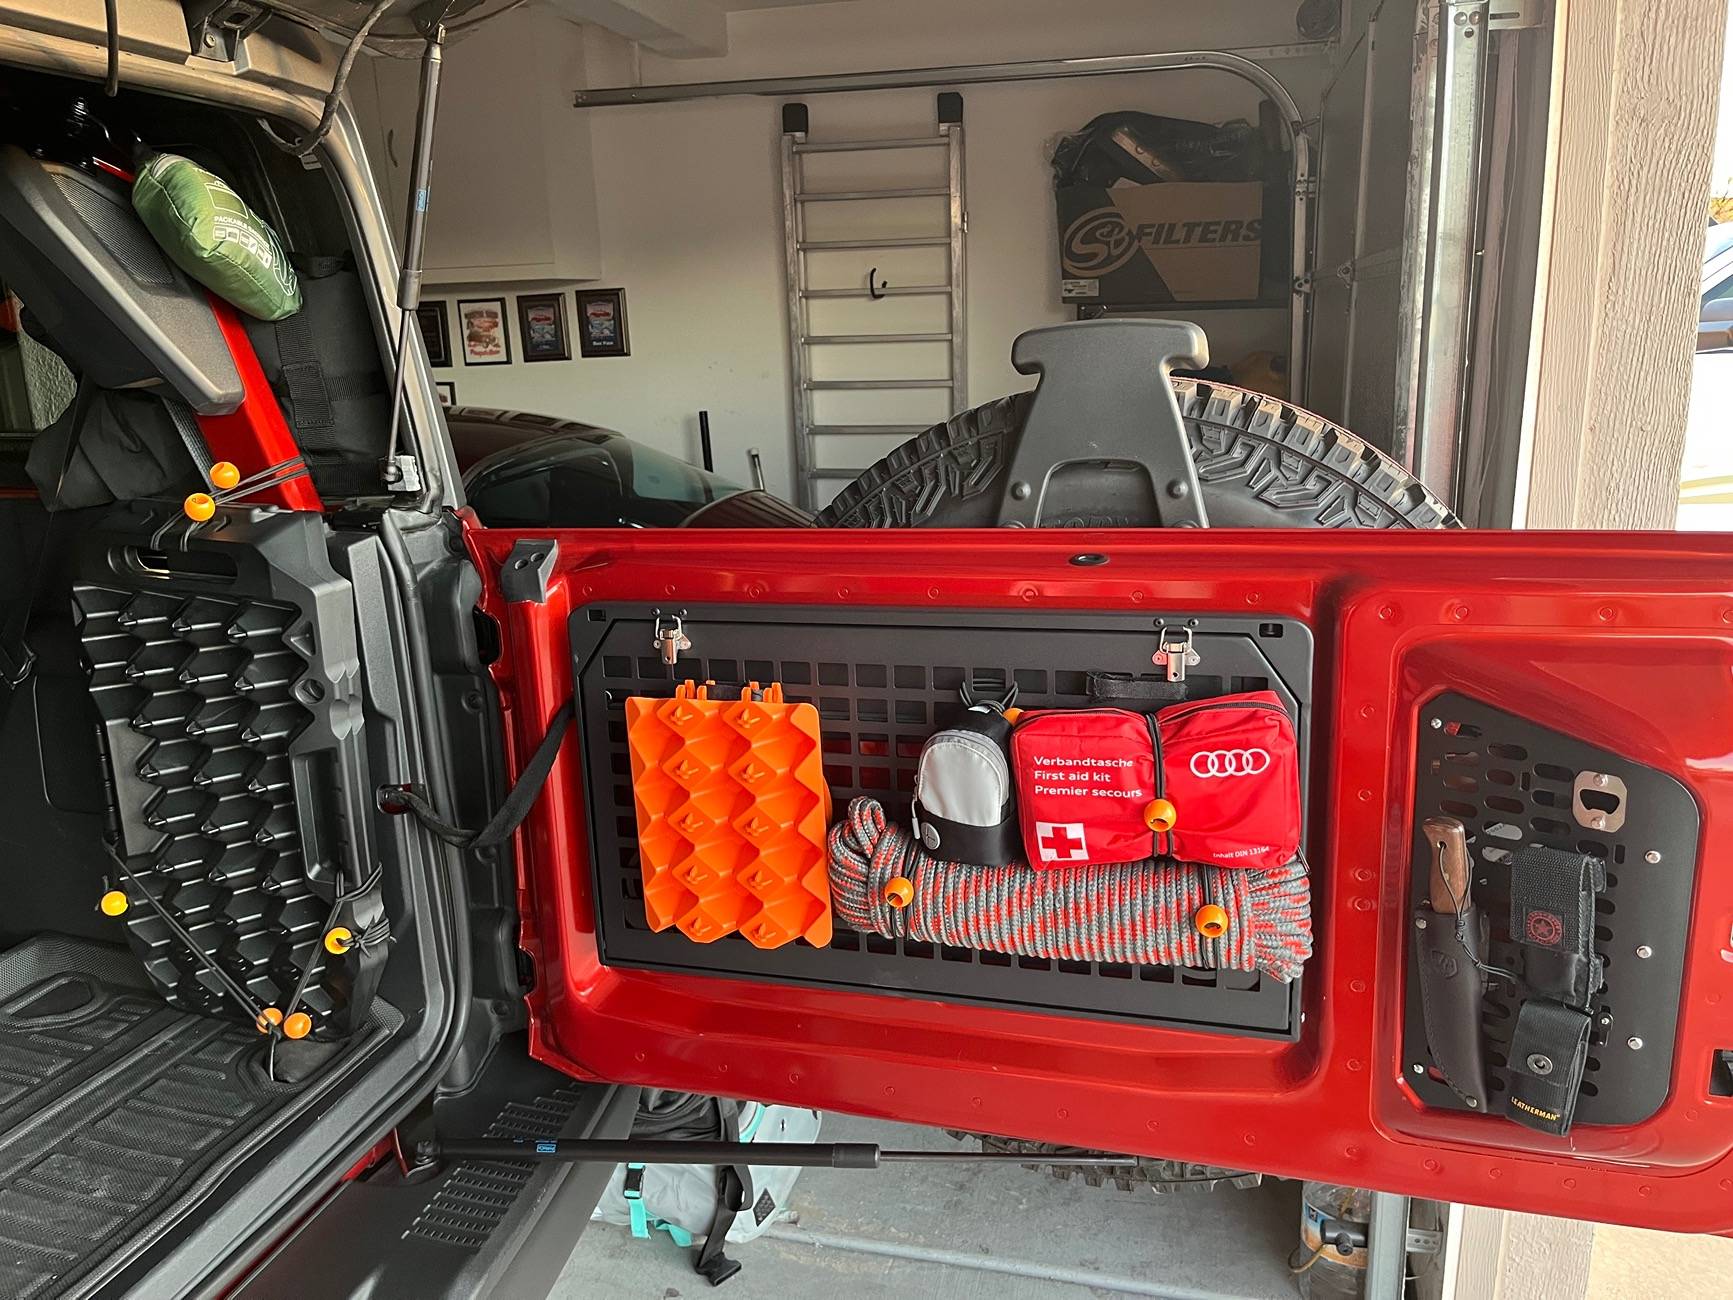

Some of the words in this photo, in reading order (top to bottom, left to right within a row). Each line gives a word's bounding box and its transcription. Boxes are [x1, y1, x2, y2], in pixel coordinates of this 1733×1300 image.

[1136, 218, 1263, 245] FILTERS
[1033, 756, 1133, 768] Verbandtasche
[1034, 770, 1065, 780] First
[1068, 772, 1089, 781] aid
[1093, 772, 1111, 782] kit
[1035, 785, 1088, 796] Premier
[1091, 788, 1143, 798] secours
[1234, 850, 1249, 858] DIN
[1511, 1096, 1558, 1121] LEATHERMAN
